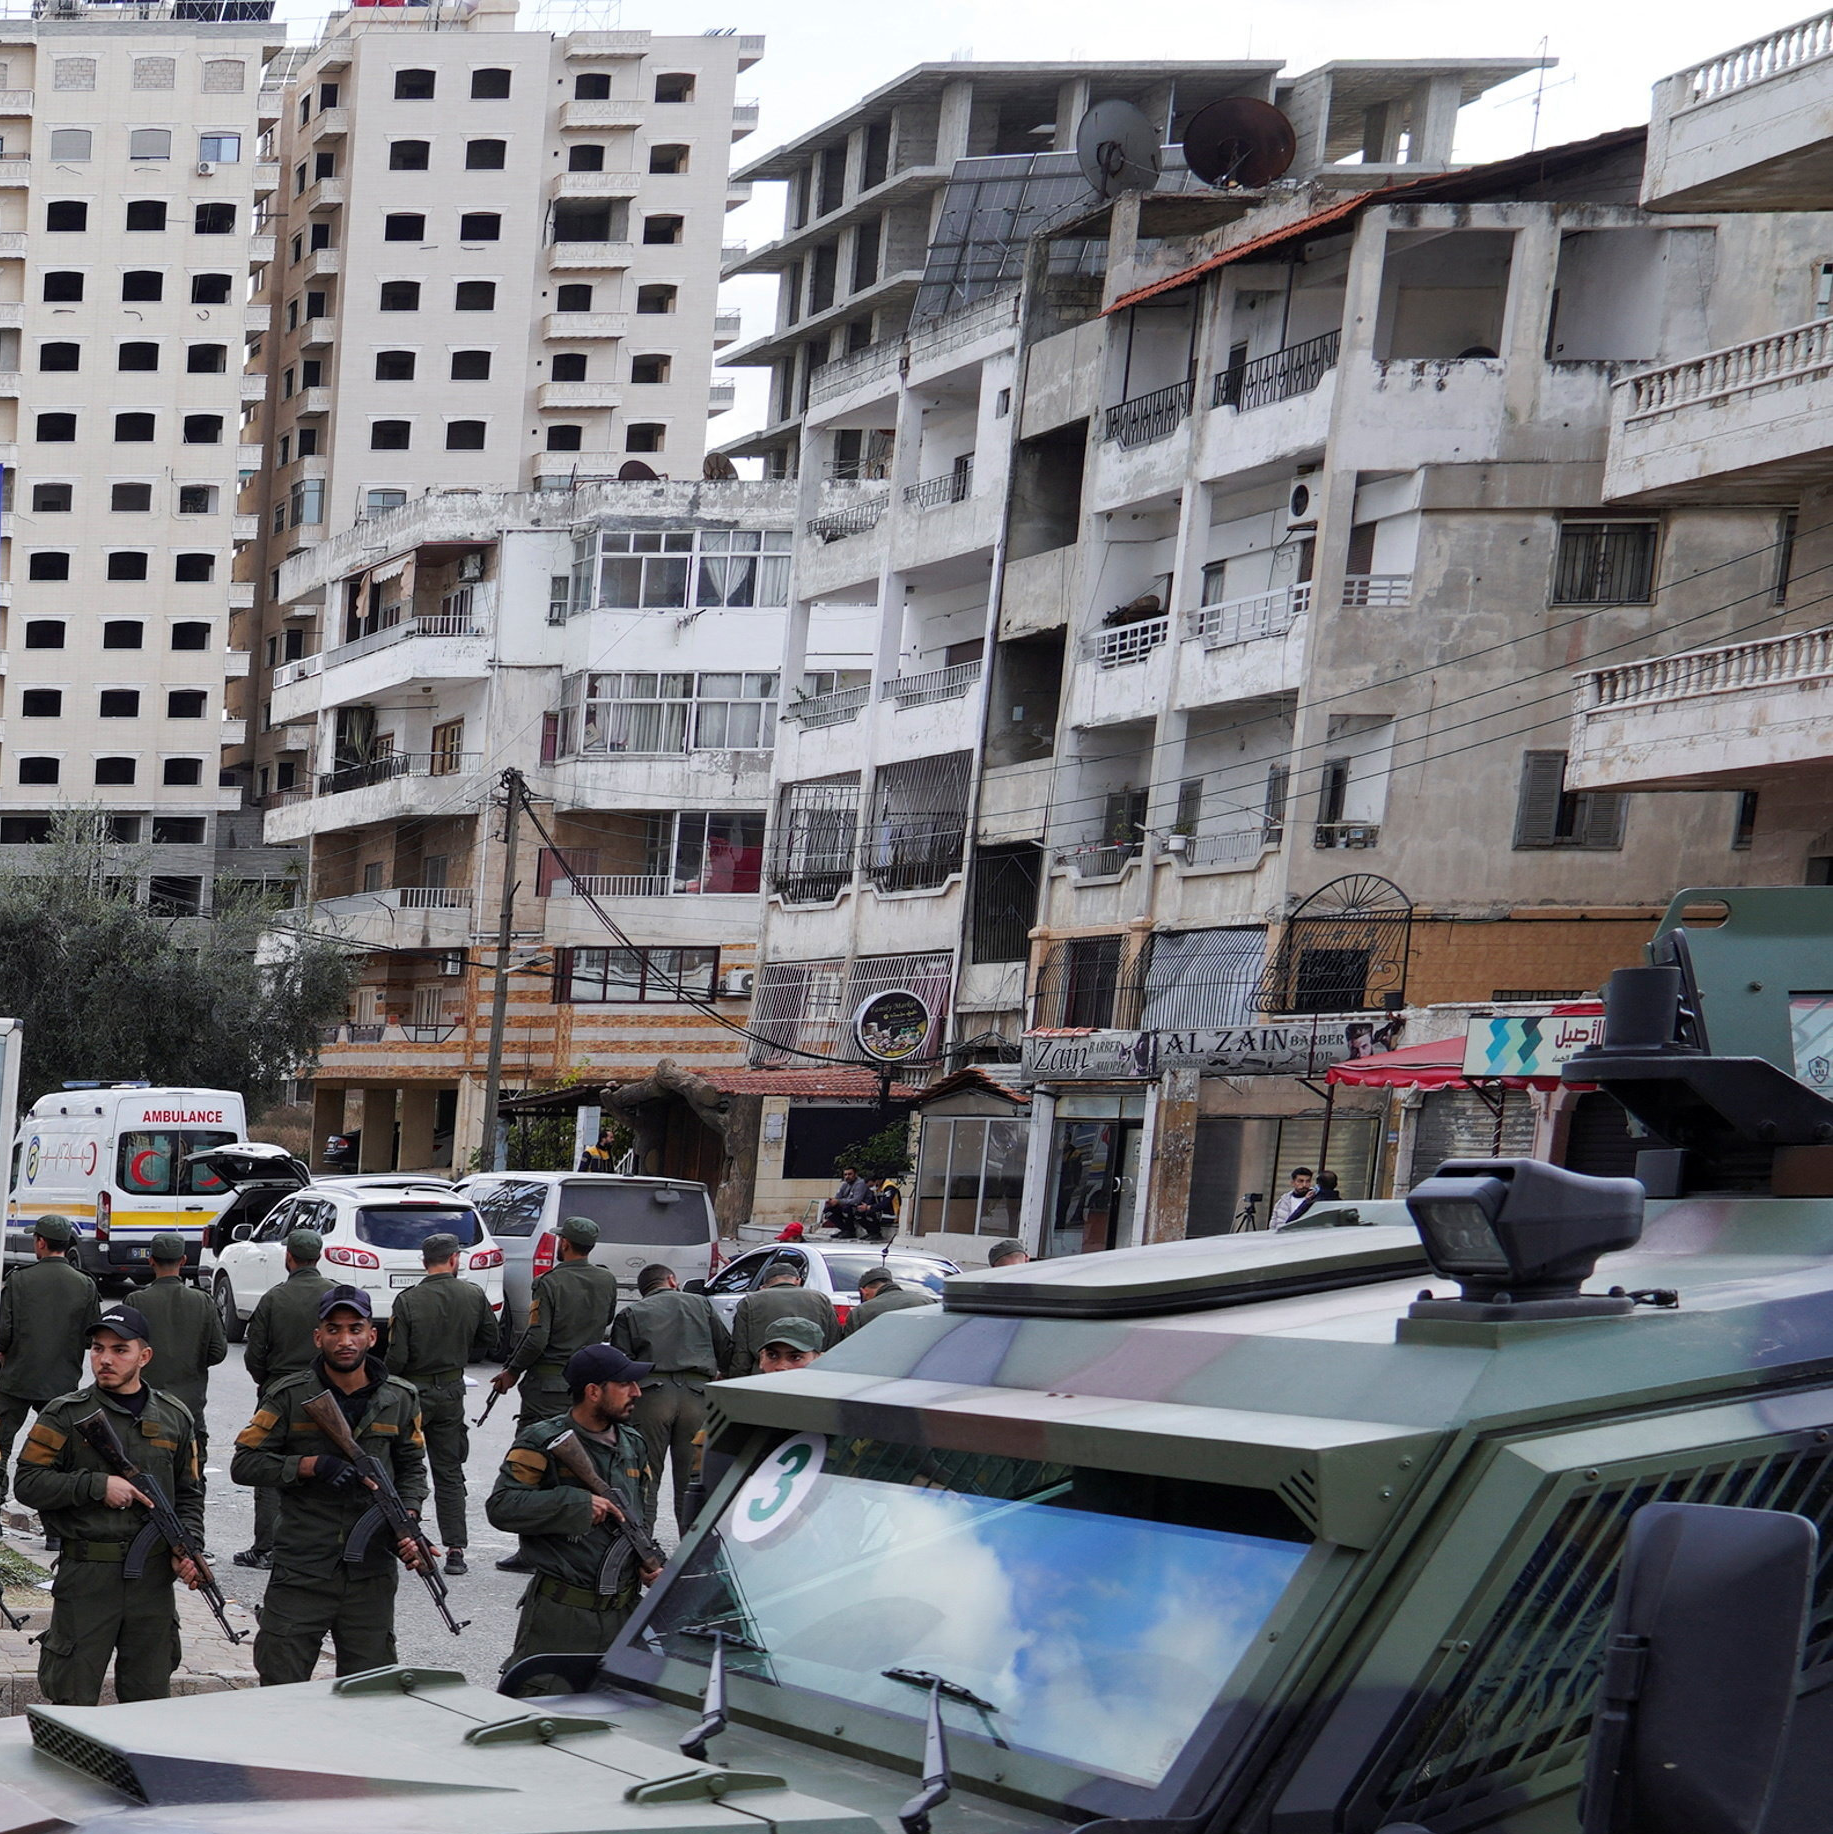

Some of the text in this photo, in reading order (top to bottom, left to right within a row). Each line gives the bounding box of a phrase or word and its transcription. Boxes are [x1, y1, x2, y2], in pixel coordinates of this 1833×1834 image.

[1089, 1041, 1121, 1053] BARBER
[1163, 1028, 1289, 1055] AL ZAIN
[1555, 1019, 1606, 1049] الأصيل
[1033, 1037, 1091, 1073] Zain
[142, 1110, 223, 1123] AMBULANCE
[748, 1443, 813, 1522] 3
